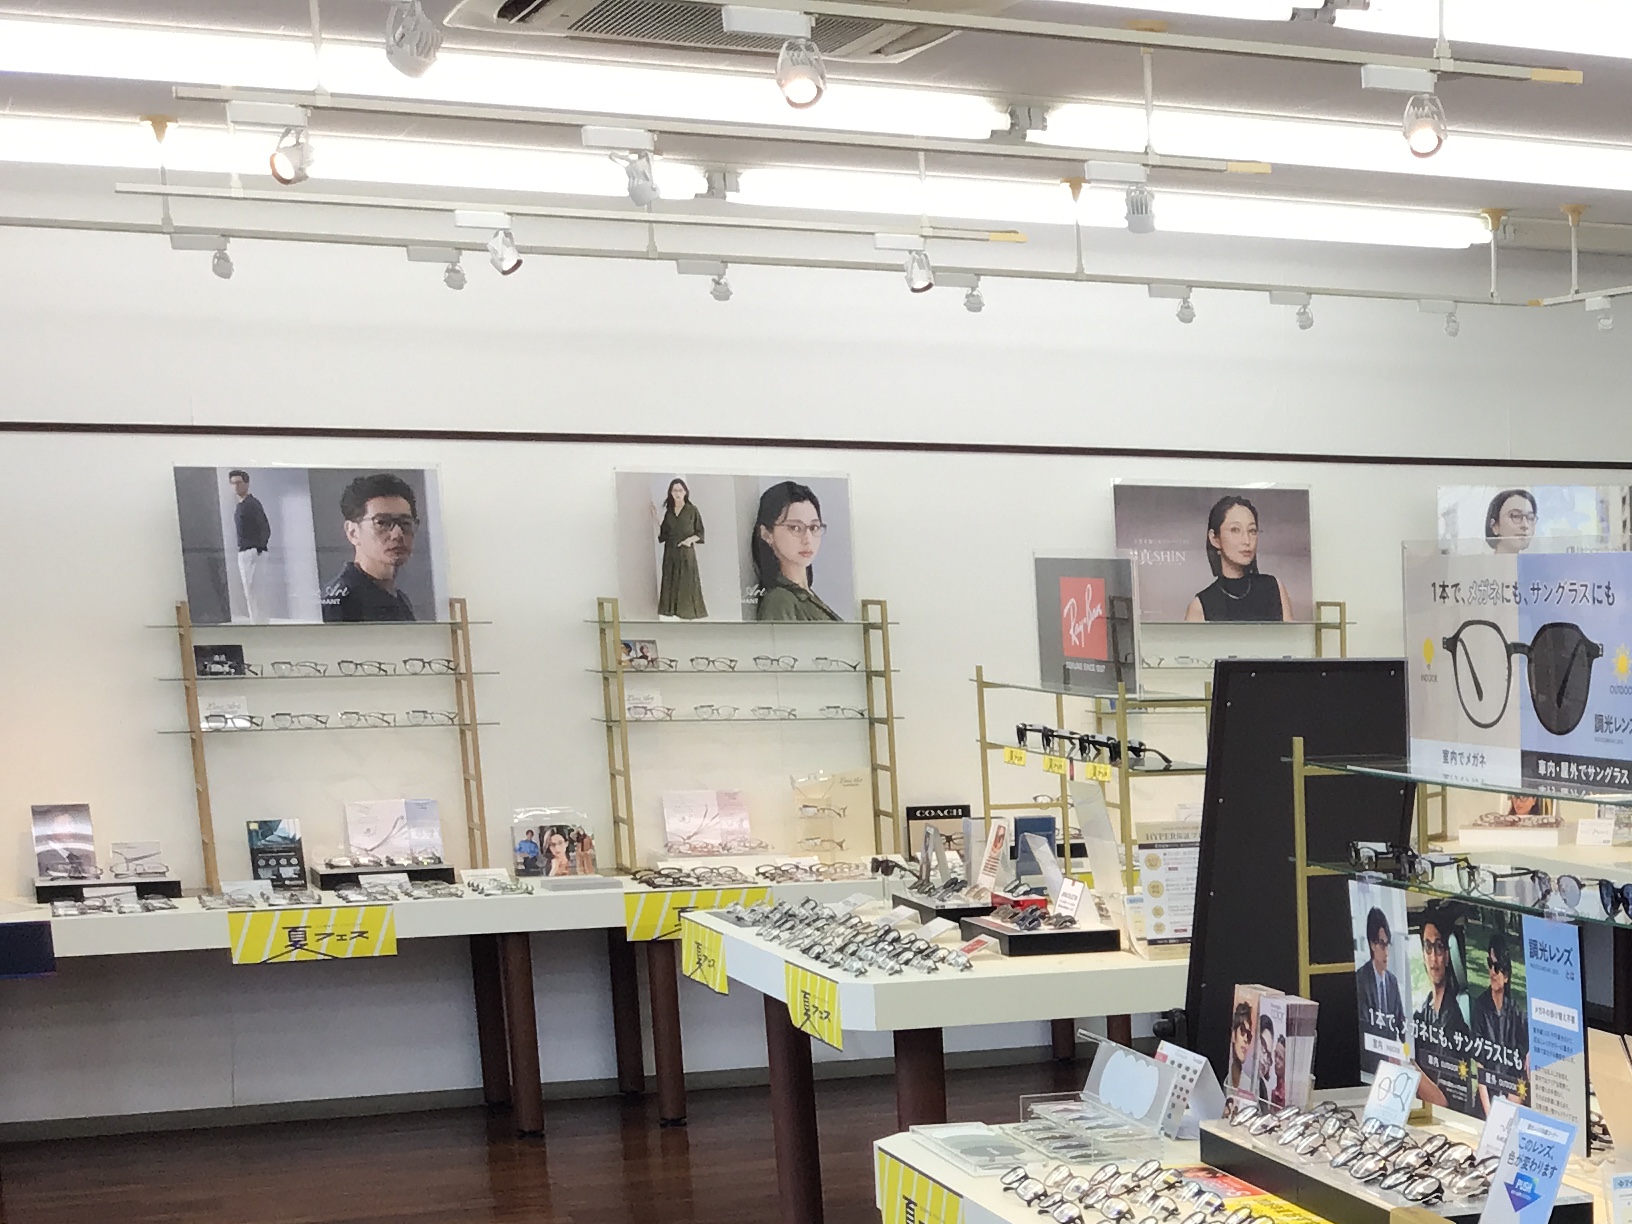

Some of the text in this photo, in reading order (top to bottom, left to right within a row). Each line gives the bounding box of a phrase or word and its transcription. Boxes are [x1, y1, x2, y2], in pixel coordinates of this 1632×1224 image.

[1442, 749, 1487, 769] 室内でメガネ
[916, 808, 963, 818] COACH
[1528, 938, 1574, 967] 調光レンズ
[1507, 1150, 1558, 1179] 色が変わります
